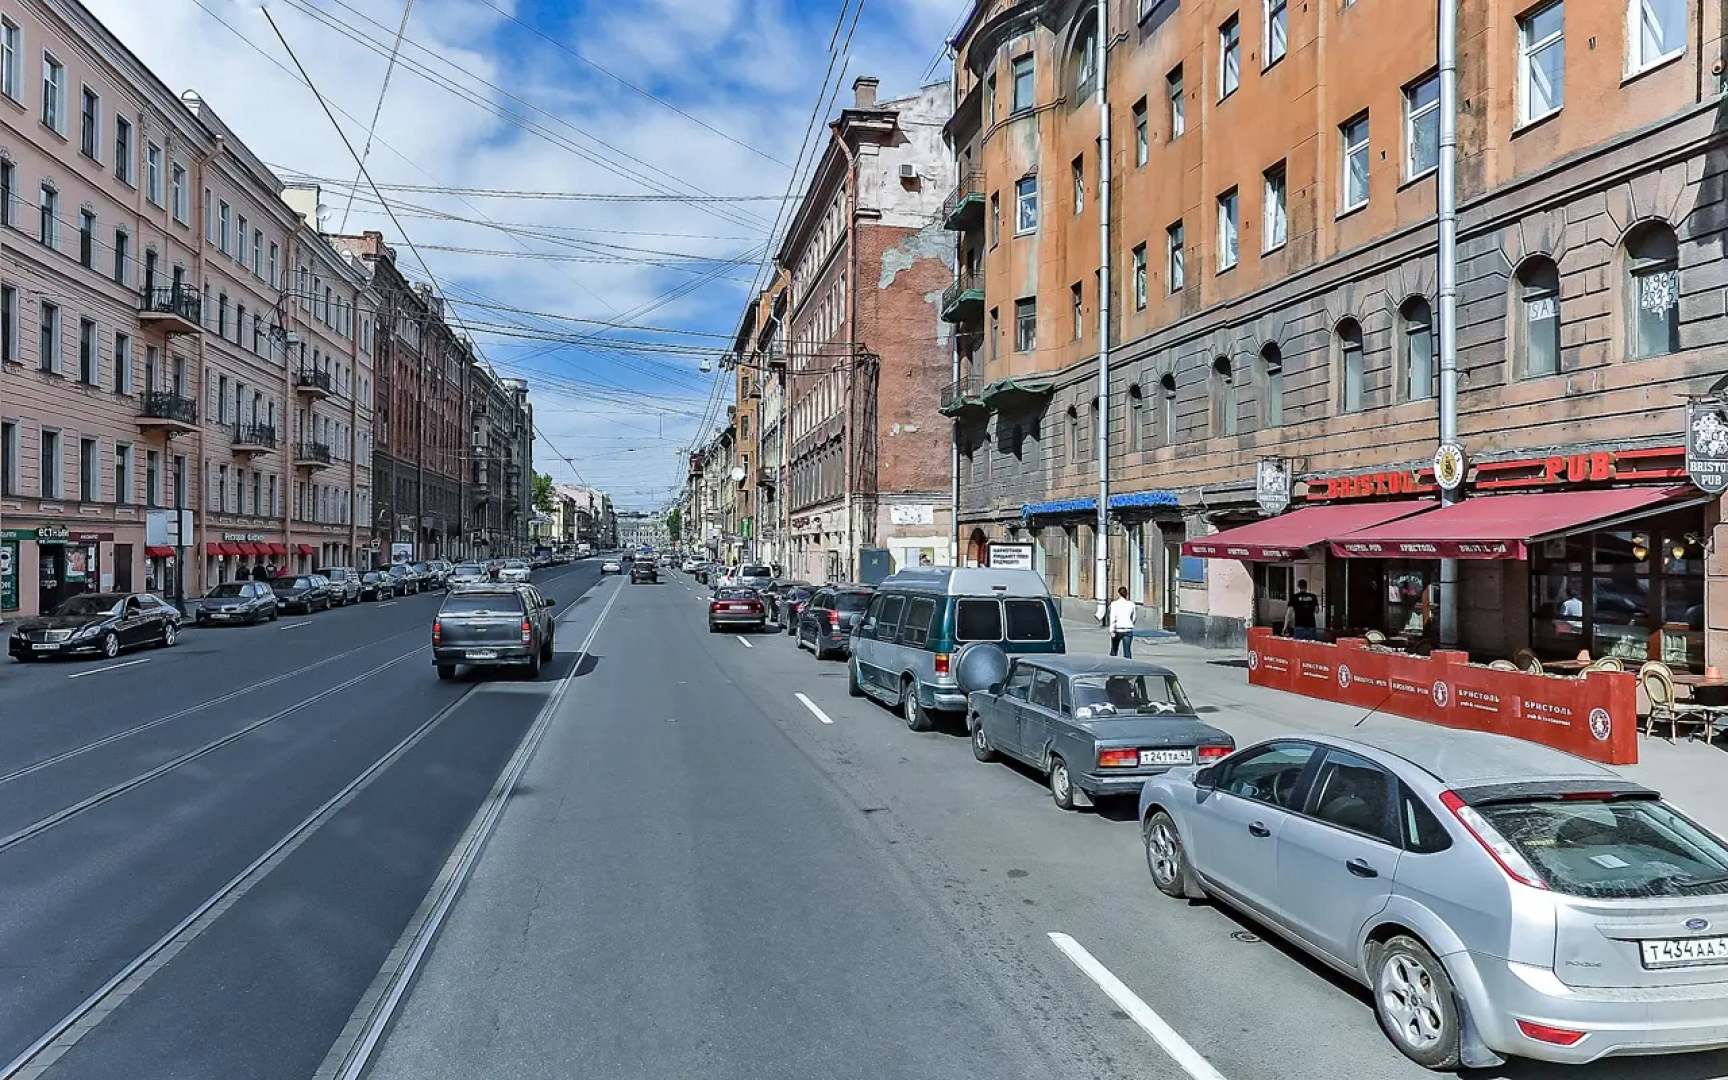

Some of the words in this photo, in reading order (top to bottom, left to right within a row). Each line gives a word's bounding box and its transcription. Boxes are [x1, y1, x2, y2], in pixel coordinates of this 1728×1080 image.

[1690, 461, 1728, 473] BRISTO
[1327, 471, 1415, 499] BRISTOL
[1546, 452, 1611, 483] PUB
[1701, 474, 1722, 485] PUB
[1458, 690, 1500, 703] БРИСТОЛЬ
[1524, 701, 1572, 716] БРИСТОЛЬ
